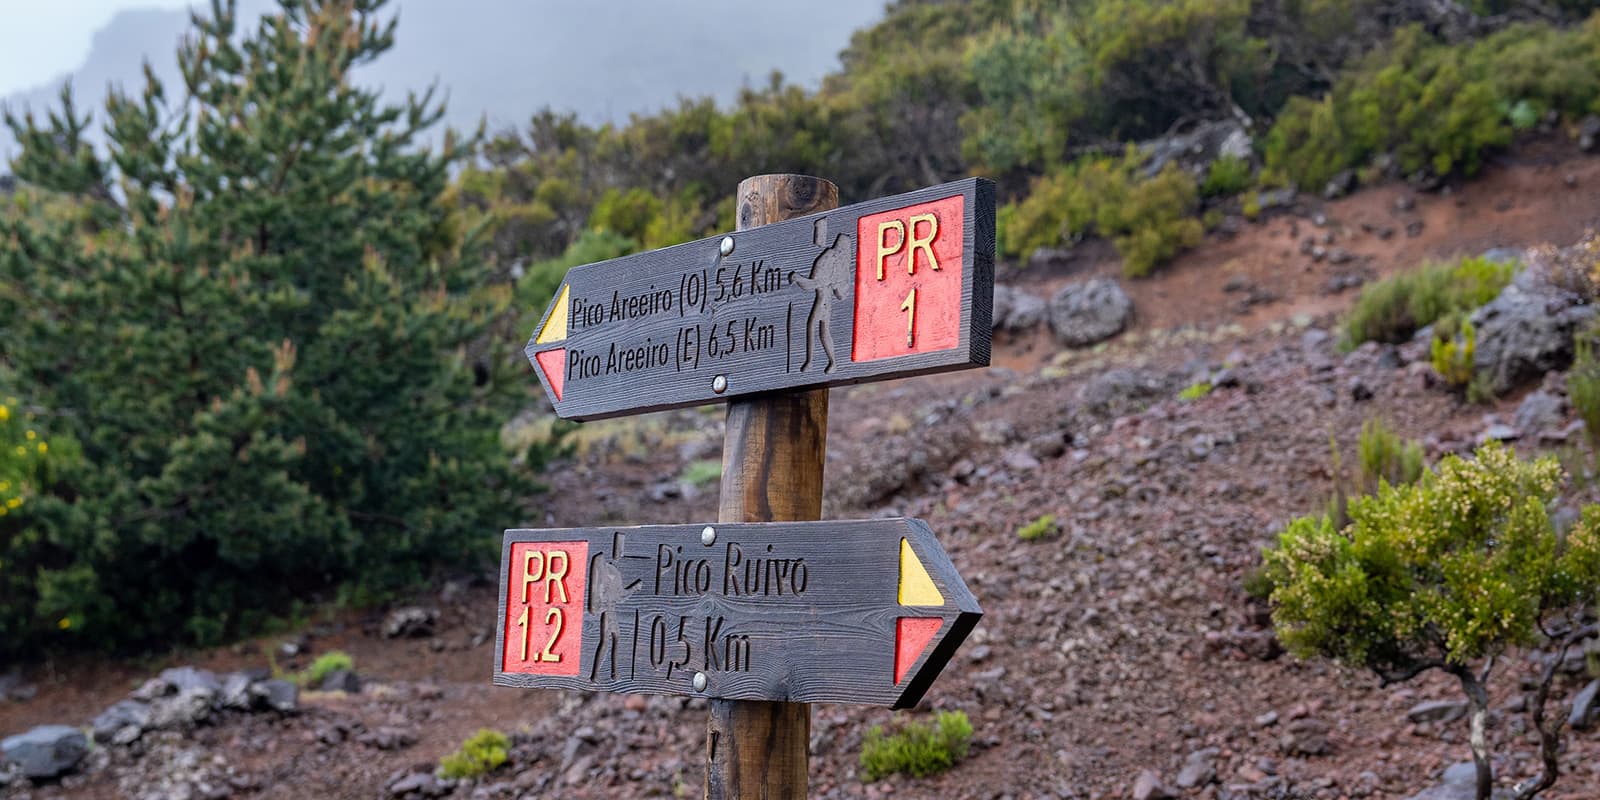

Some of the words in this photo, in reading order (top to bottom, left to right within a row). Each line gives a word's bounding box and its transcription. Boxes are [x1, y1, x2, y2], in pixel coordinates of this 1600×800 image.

[876, 213, 941, 280] PR
[572, 296, 603, 330] Pico
[608, 284, 672, 323] Areeiro
[679, 269, 707, 316] (O)
[714, 265, 744, 305] 5,6
[749, 260, 782, 292] Km
[900, 289, 918, 348] 1
[567, 348, 600, 381] Pico
[605, 338, 668, 375] Areeiro
[676, 325, 702, 372] (E)
[708, 321, 737, 360] 6,5
[743, 316, 775, 350] Km
[521, 549, 569, 604] PR
[654, 543, 711, 597] Pico
[722, 542, 808, 598] Ruivo
[517, 605, 563, 663] 1.2
[650, 614, 692, 680] 0,5
[704, 615, 751, 673] Km
